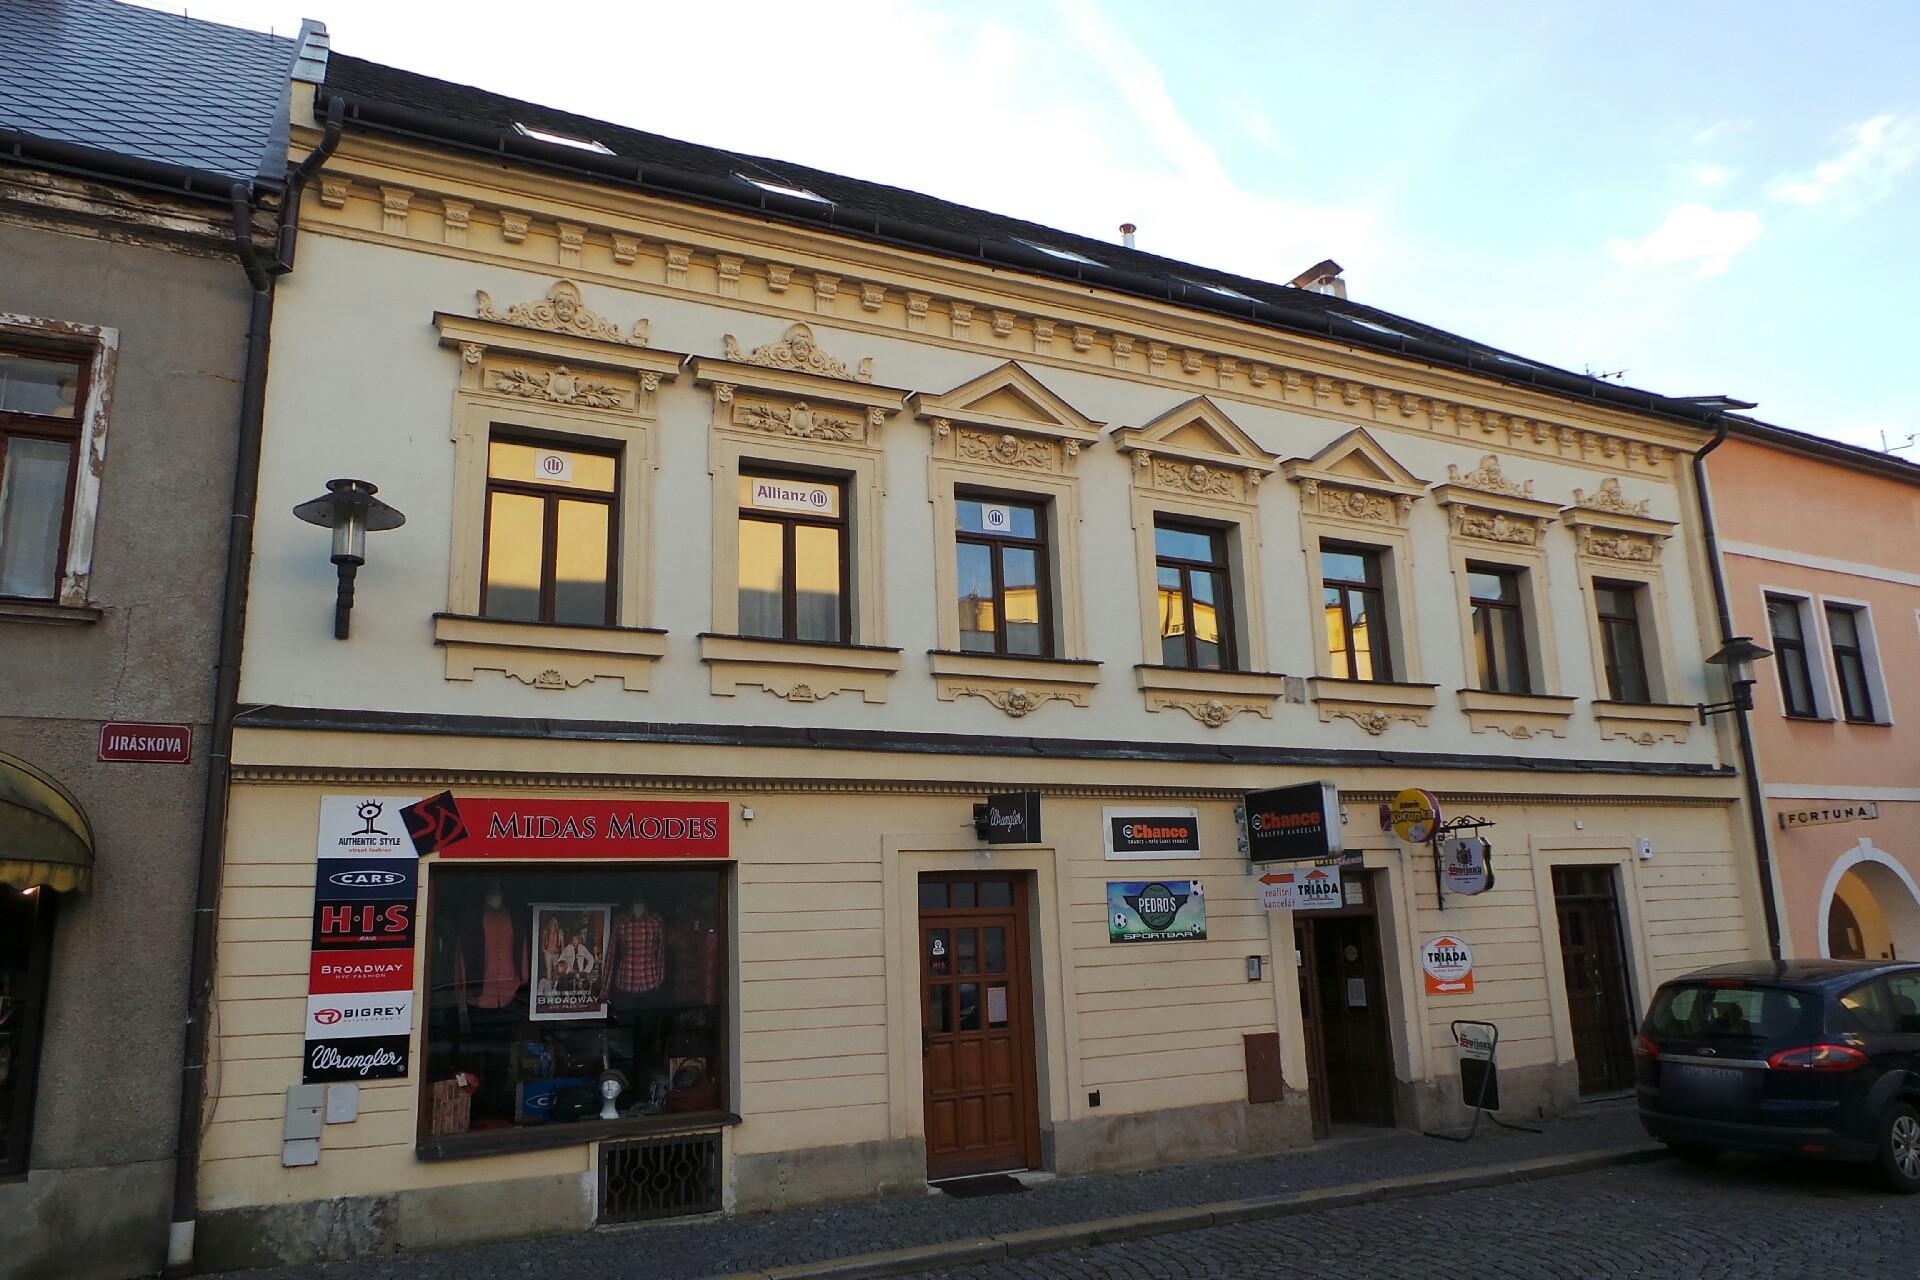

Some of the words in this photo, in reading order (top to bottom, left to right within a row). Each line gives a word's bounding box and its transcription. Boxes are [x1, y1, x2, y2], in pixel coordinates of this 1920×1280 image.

[758, 484, 807, 502] Allianz
[108, 734, 182, 752] JIRÁSKOVA
[990, 807, 1024, 833] Wrangler
[1262, 810, 1321, 830] Chance
[1788, 807, 1867, 823] FORTUNA
[487, 811, 597, 839] MIDAS
[606, 812, 717, 840] MODES
[1132, 823, 1189, 839] Chance
[338, 837, 377, 846] AUTHENTIC
[379, 837, 401, 846] STYLE
[341, 873, 395, 884] CARS
[1297, 883, 1339, 896] TRIADA
[1123, 931, 1193, 940] SPORTBAR
[1428, 952, 1467, 963] TRIADA
[321, 964, 404, 974] BROADWAY
[538, 996, 600, 1005] BROADWAY
[344, 1006, 405, 1018] BIGREY
[312, 1044, 403, 1076] Wrangler
